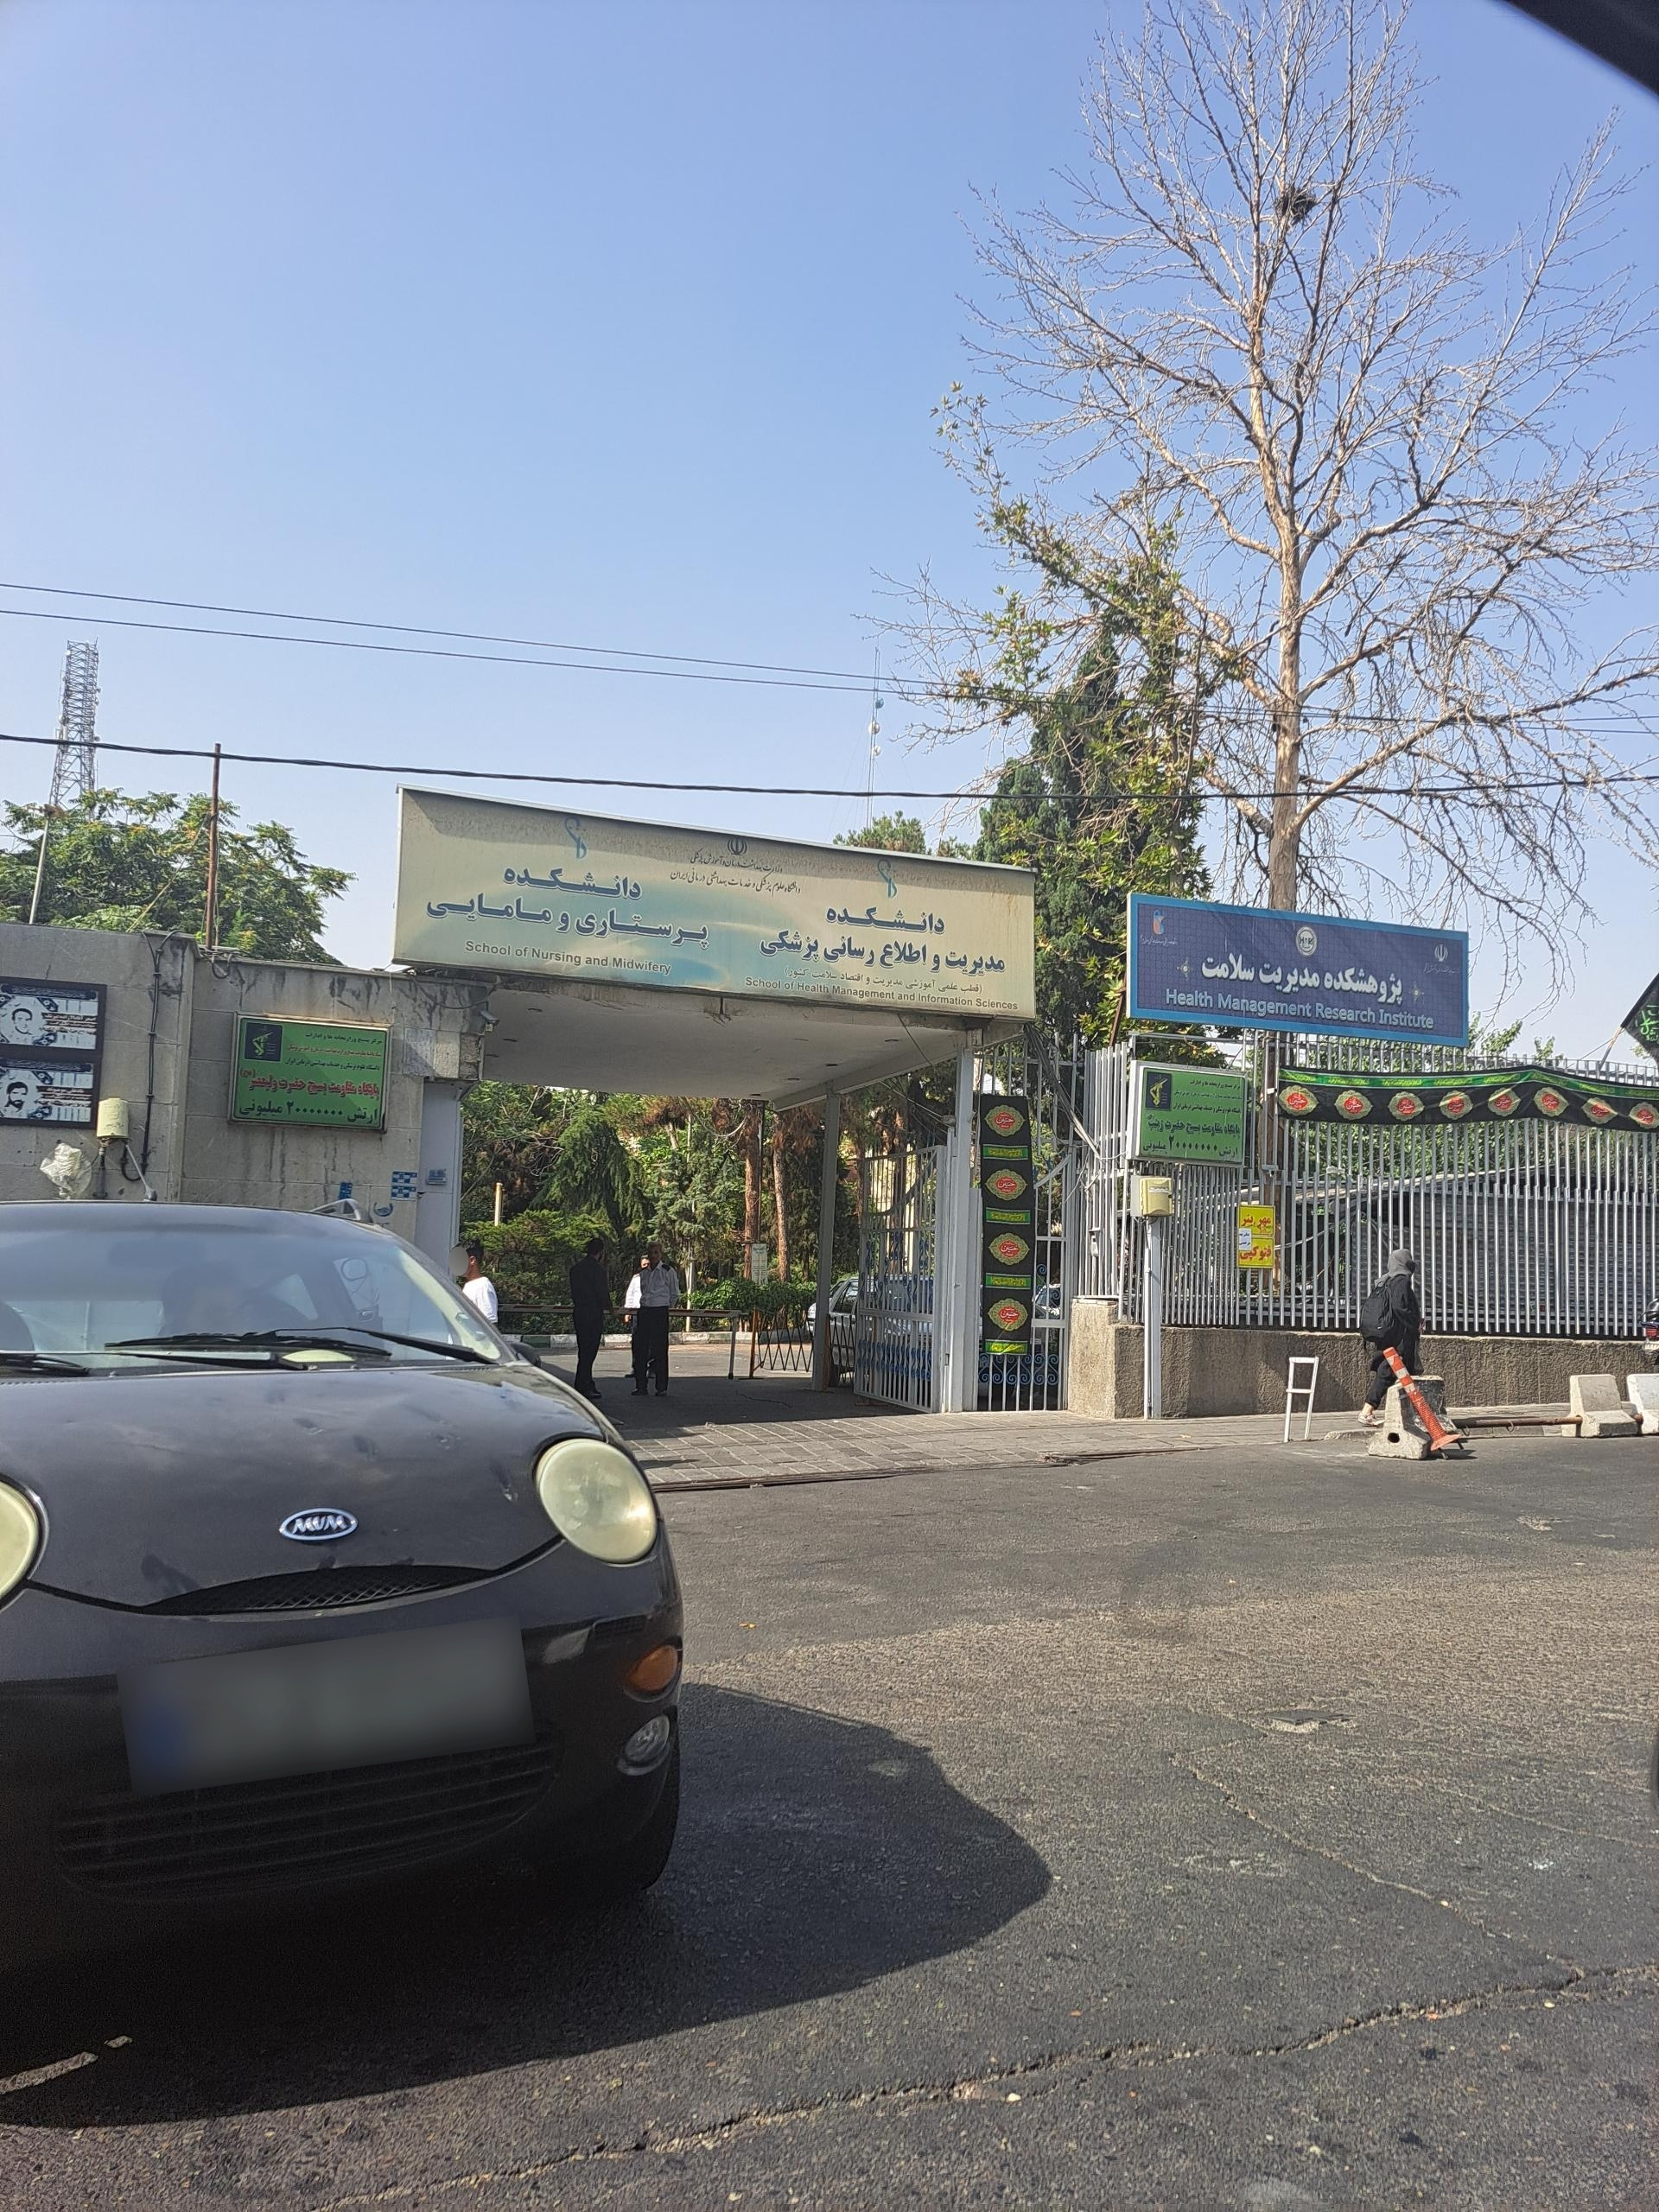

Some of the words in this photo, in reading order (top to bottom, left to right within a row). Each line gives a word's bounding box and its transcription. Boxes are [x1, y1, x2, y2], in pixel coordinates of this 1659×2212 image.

[504, 867, 641, 899] دانشکده
[670, 870, 688, 880] ایران
[688, 868, 705, 883] درمانی
[707, 871, 728, 887] بهداشتی
[728, 878, 752, 887] خدمات
[756, 872, 772, 892] پزشکی
[772, 884, 785, 898] علوم
[427, 893, 552, 921] مامایی
[556, 912, 571, 933] و
[575, 909, 709, 949] پرستاری
[825, 906, 944, 935] دانشکده
[466, 940, 511, 957] School
[514, 947, 529, 957] of
[531, 949, 582, 967] Nursing
[585, 955, 608, 967] and
[613, 957, 671, 975] Midwifery
[760, 931, 819, 963] پزشکی
[823, 937, 874, 967] رسانی
[879, 940, 927, 969] اطلاع
[811, 969, 837, 980] سلامت
[930, 954, 941, 972] و
[944, 950, 1006, 976] مدیریت
[1201, 952, 1255, 982] سلامت
[840, 972, 863, 982] اقتصاد
[872, 976, 902, 988] مدیریت
[905, 979, 935, 991] آموزشی
[938, 982, 957, 993] علمی
[1259, 961, 1319, 995] مدیریت
[1324, 965, 1403, 1005] پژوهشکده
[746, 976, 780, 990] School
[784, 982, 796, 991] of
[798, 982, 829, 994] Health
[832, 985, 894, 1000] Management
[897, 992, 915, 1001] and
[918, 994, 972, 1007] Information
[976, 996, 1019, 1010] Sciences
[1165, 988, 1213, 1008] Health
[1217, 996, 1313, 1018] Management
[1315, 1003, 1376, 1024] Research
[1379, 1008, 1434, 1030] Institute
[347, 1107, 378, 1124] ارتش
